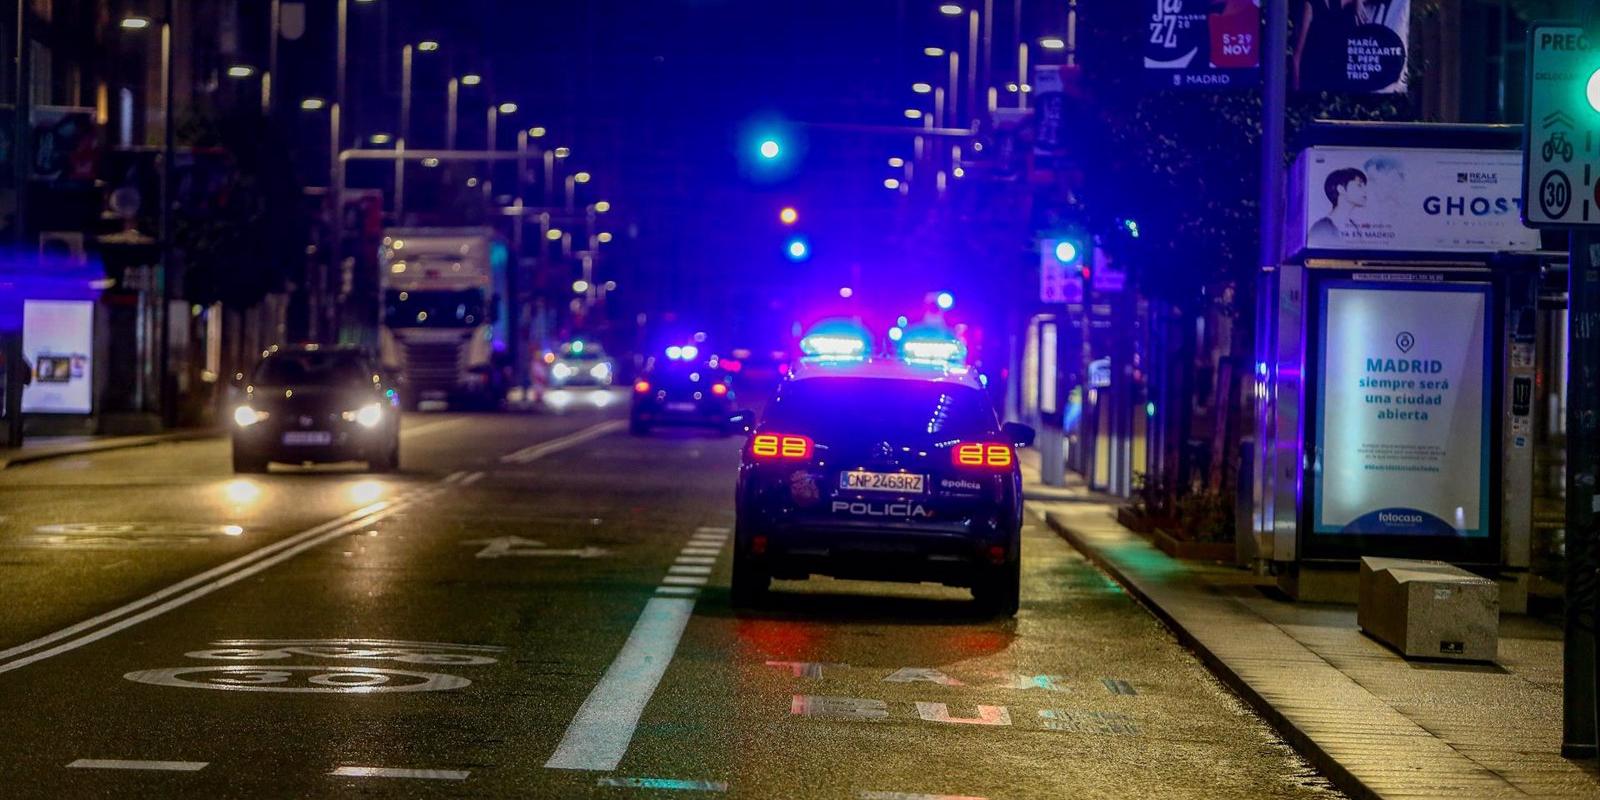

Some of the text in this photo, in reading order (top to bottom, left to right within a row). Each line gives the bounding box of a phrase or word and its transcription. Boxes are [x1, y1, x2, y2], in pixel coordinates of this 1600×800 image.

[1223, 45, 1252, 55] NOV
[1358, 55, 1380, 64] PEPE
[1347, 63, 1382, 72] RIVERO
[1186, 74, 1231, 84] MADRID
[1346, 71, 1370, 80] TRIO
[1469, 172, 1497, 180] REALE
[1546, 182, 1566, 208] 30
[1366, 358, 1443, 373] MADRID
[1359, 376, 1449, 391] siempre será
[1365, 393, 1442, 405] una ciudad
[1377, 408, 1429, 421] abierta
[832, 499, 927, 517] POLICÍA
[1378, 511, 1424, 523] fotocasa
